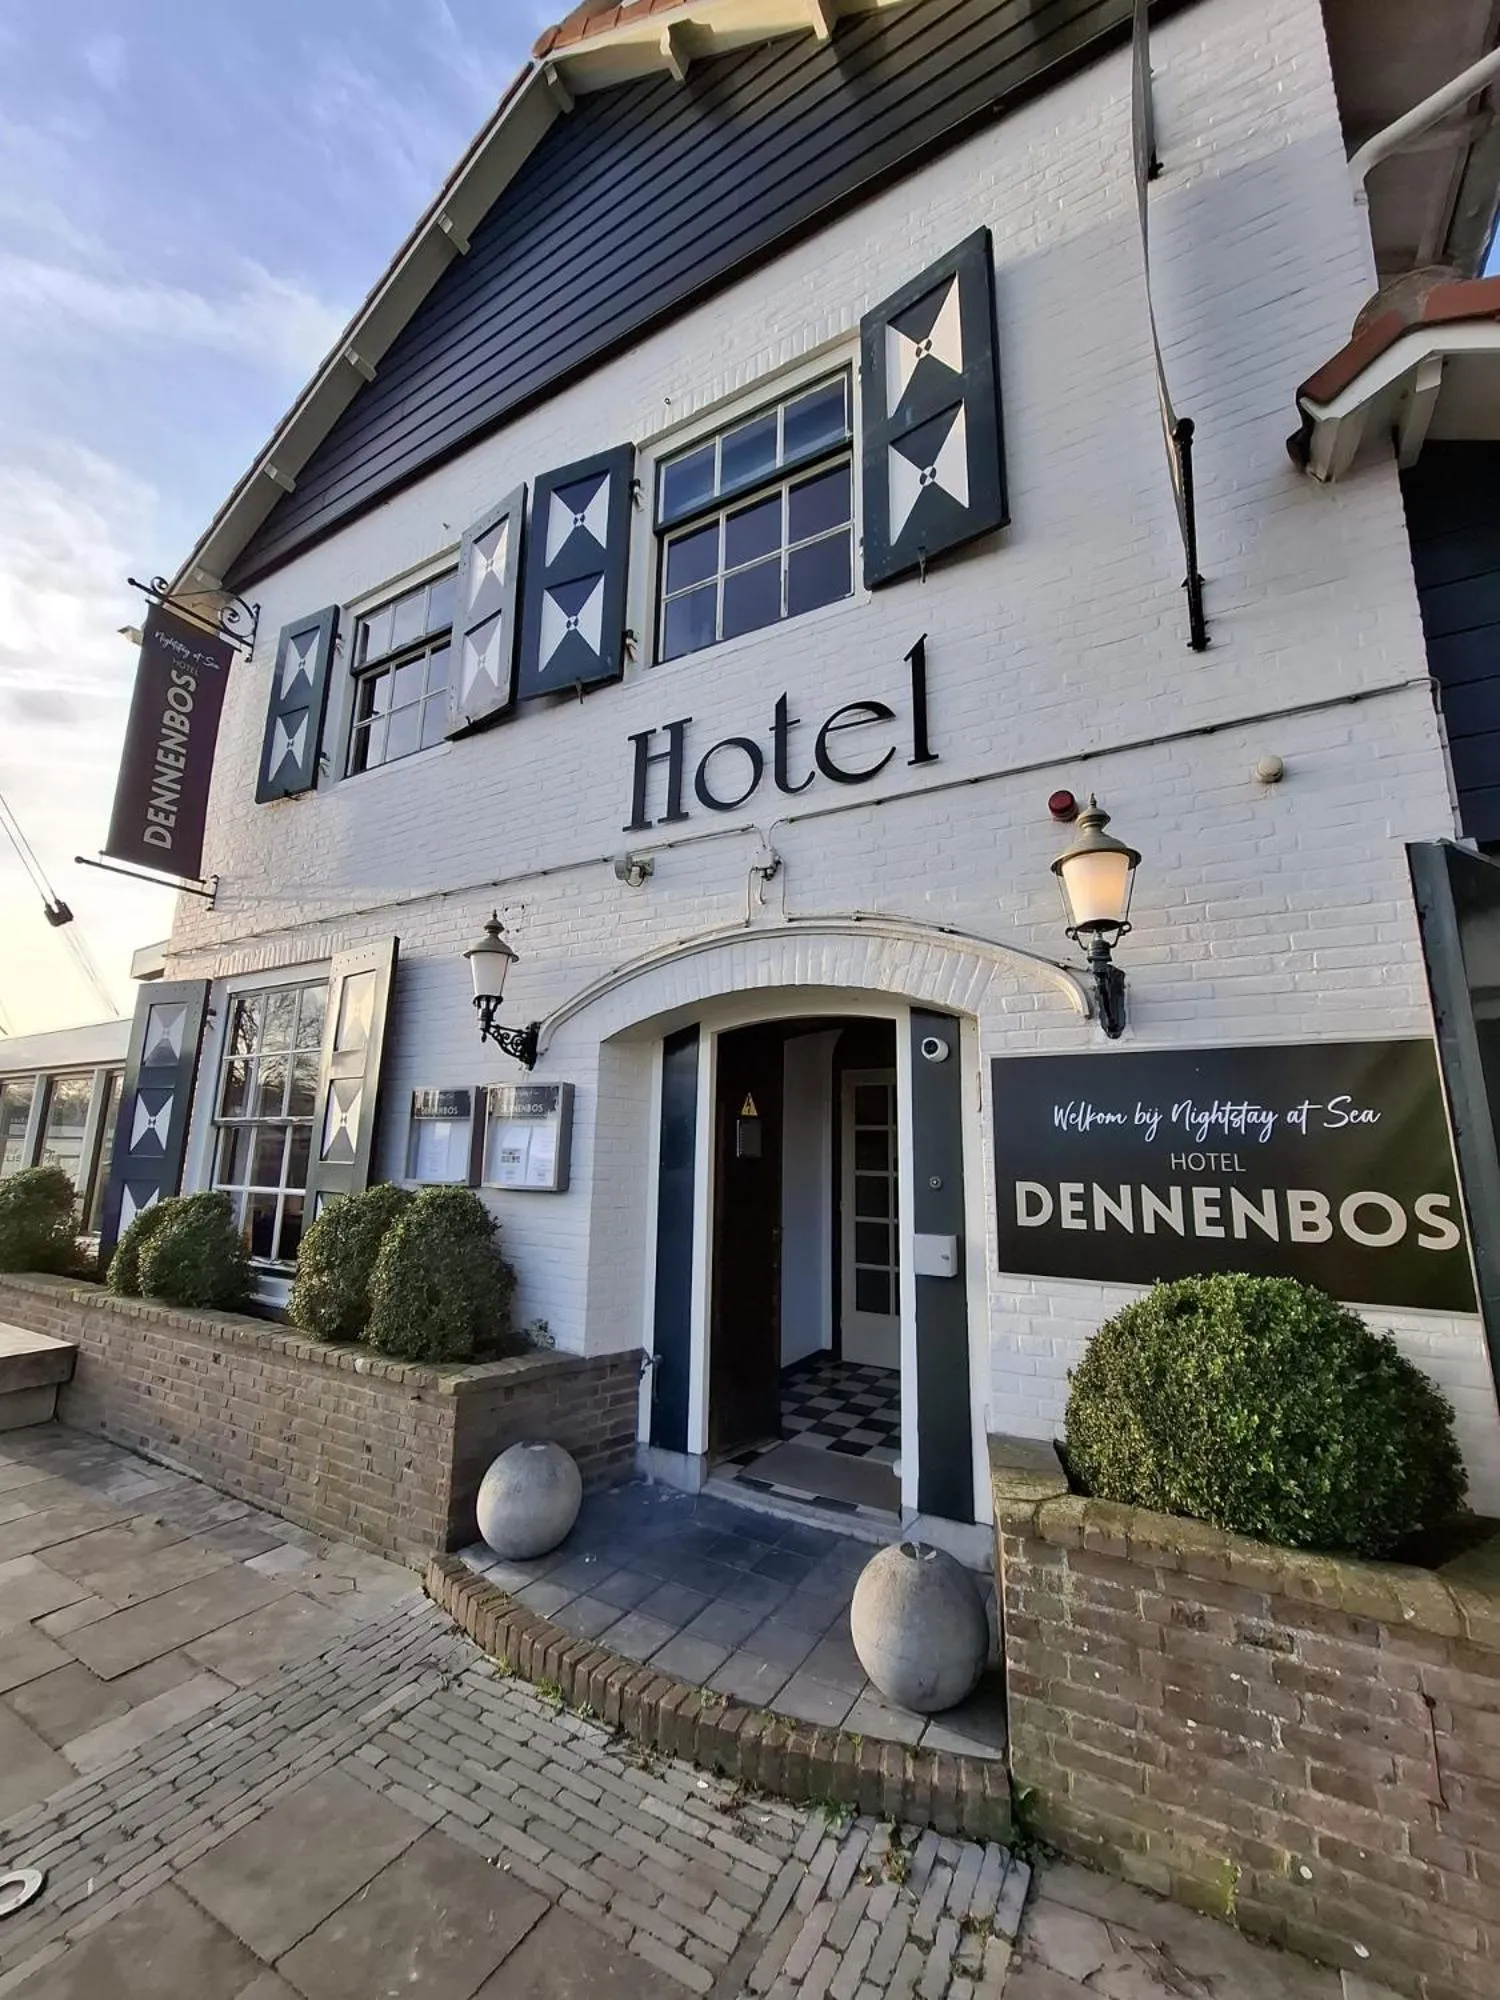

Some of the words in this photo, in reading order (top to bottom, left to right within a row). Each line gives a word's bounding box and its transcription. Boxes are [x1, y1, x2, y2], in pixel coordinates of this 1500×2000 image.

[143, 669, 197, 849] DENNENBOS
[622, 632, 939, 832] Hotel
[1053, 1100, 1127, 1133] Welkom
[1133, 1101, 1163, 1142] bij
[1171, 1100, 1279, 1144] Nightstay
[1286, 1099, 1324, 1136] at
[1323, 1095, 1382, 1129] Sea
[1170, 1151, 1247, 1173] HOTEL
[1015, 1180, 1461, 1251] DENNENBOS
